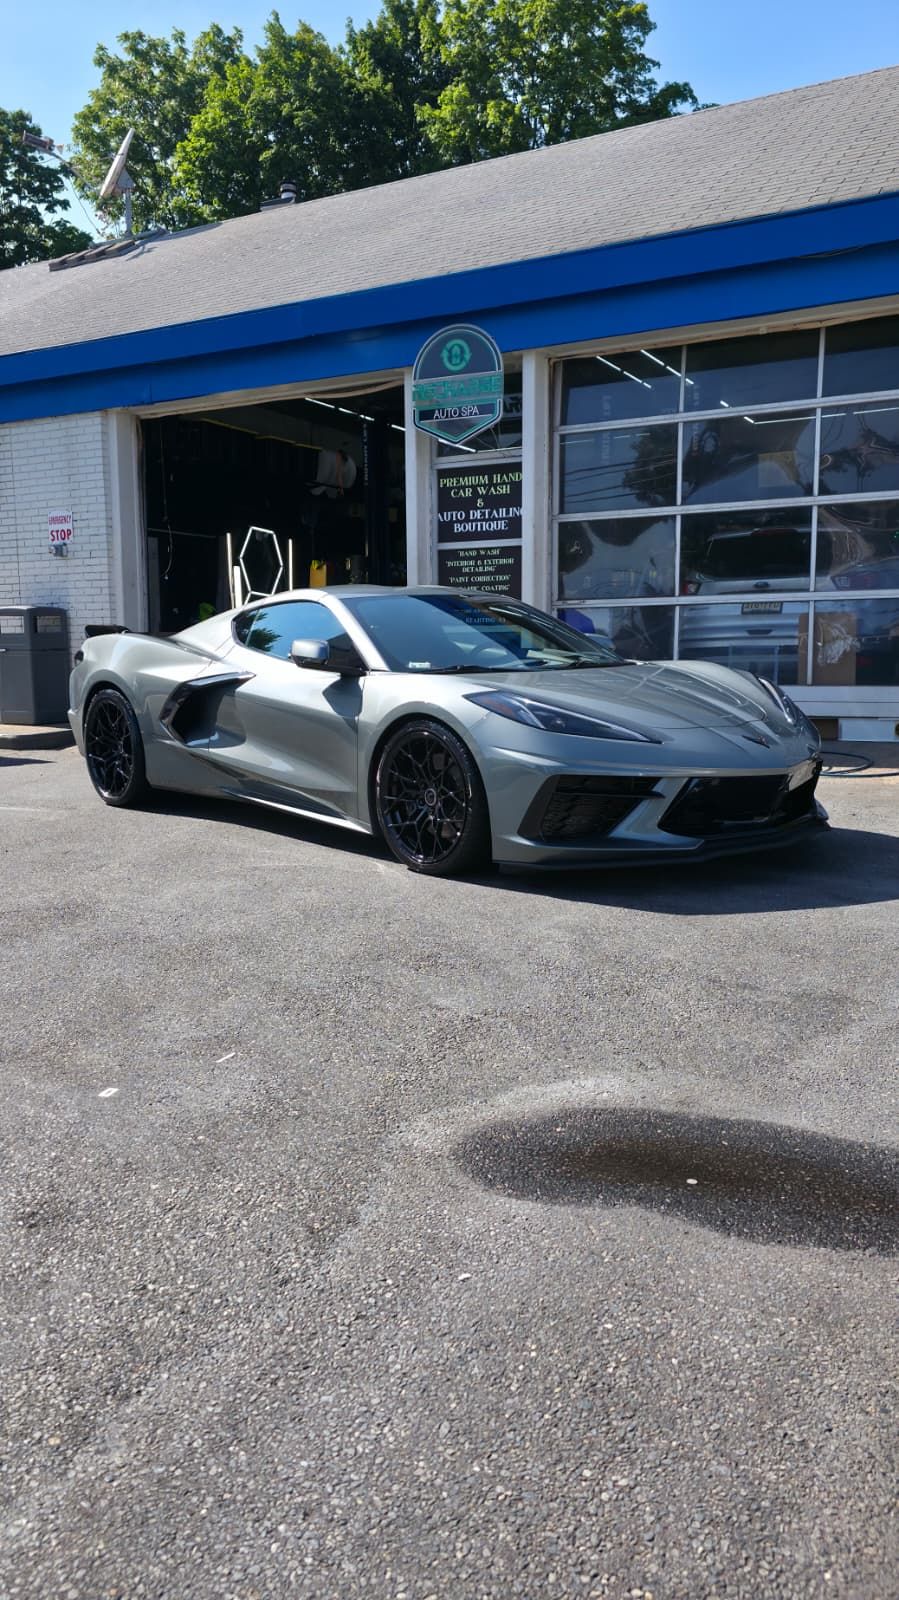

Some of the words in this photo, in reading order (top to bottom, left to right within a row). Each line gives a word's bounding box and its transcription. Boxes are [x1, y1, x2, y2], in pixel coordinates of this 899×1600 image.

[433, 407, 459, 419] AUTO
[461, 405, 480, 417] SPA
[440, 474, 488, 488] PREMIUM
[493, 472, 523, 484] HAND
[451, 487, 473, 498] CAR
[476, 484, 511, 495] WASH
[476, 498, 484, 508] &
[454, 520, 509, 533] BOUTIQUE
[50, 528, 72, 542] STOP
